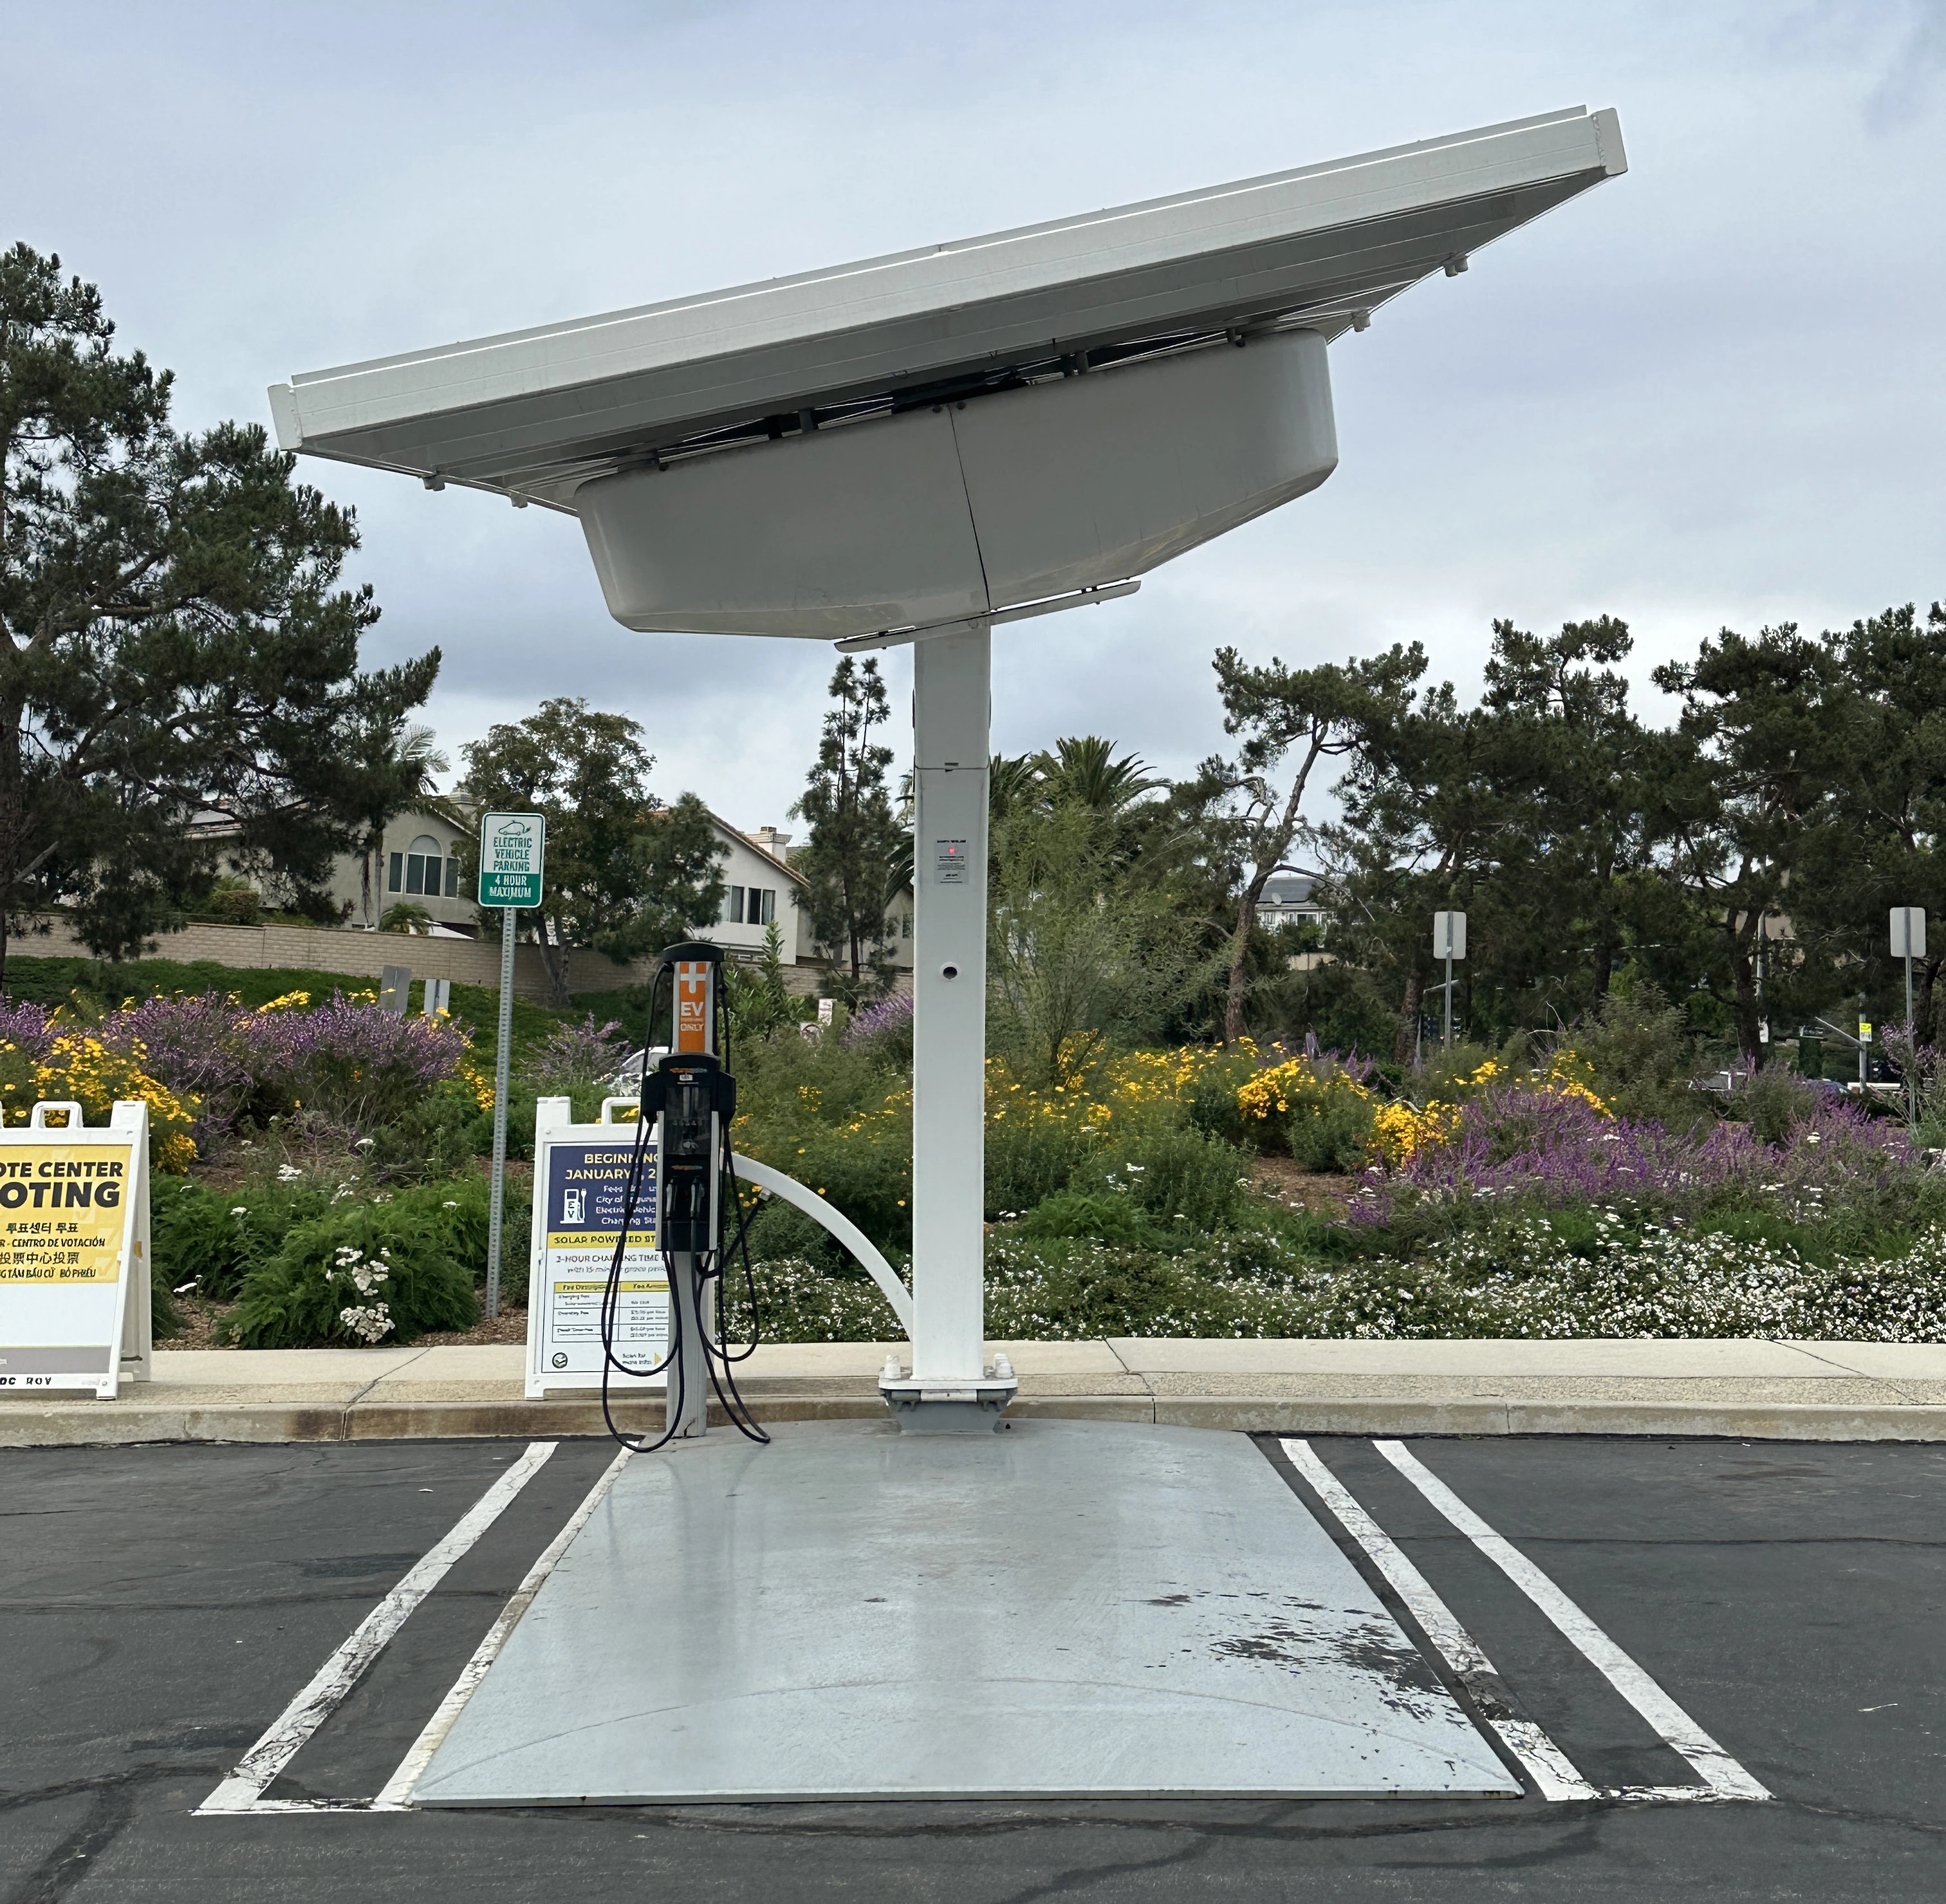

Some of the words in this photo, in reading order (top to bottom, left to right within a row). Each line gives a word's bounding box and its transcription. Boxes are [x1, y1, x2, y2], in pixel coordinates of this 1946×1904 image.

[494, 837, 532, 848] ELECTRIC
[495, 849, 530, 860] VEHICLE
[494, 861, 530, 872] PARKING
[496, 875, 501, 885] 4
[503, 875, 527, 886] HOUR
[489, 886, 532, 898] MAXIMUM
[681, 1002, 704, 1016] EV
[38, 1162, 123, 1177] CENTER
[565, 1168, 631, 1180] JANUARY
[0, 1181, 120, 1208] OTING
[12, 1238, 46, 1247] CENTRO
[48, 1238, 59, 1247] DE
[61, 1236, 106, 1247] VOTACIÓN
